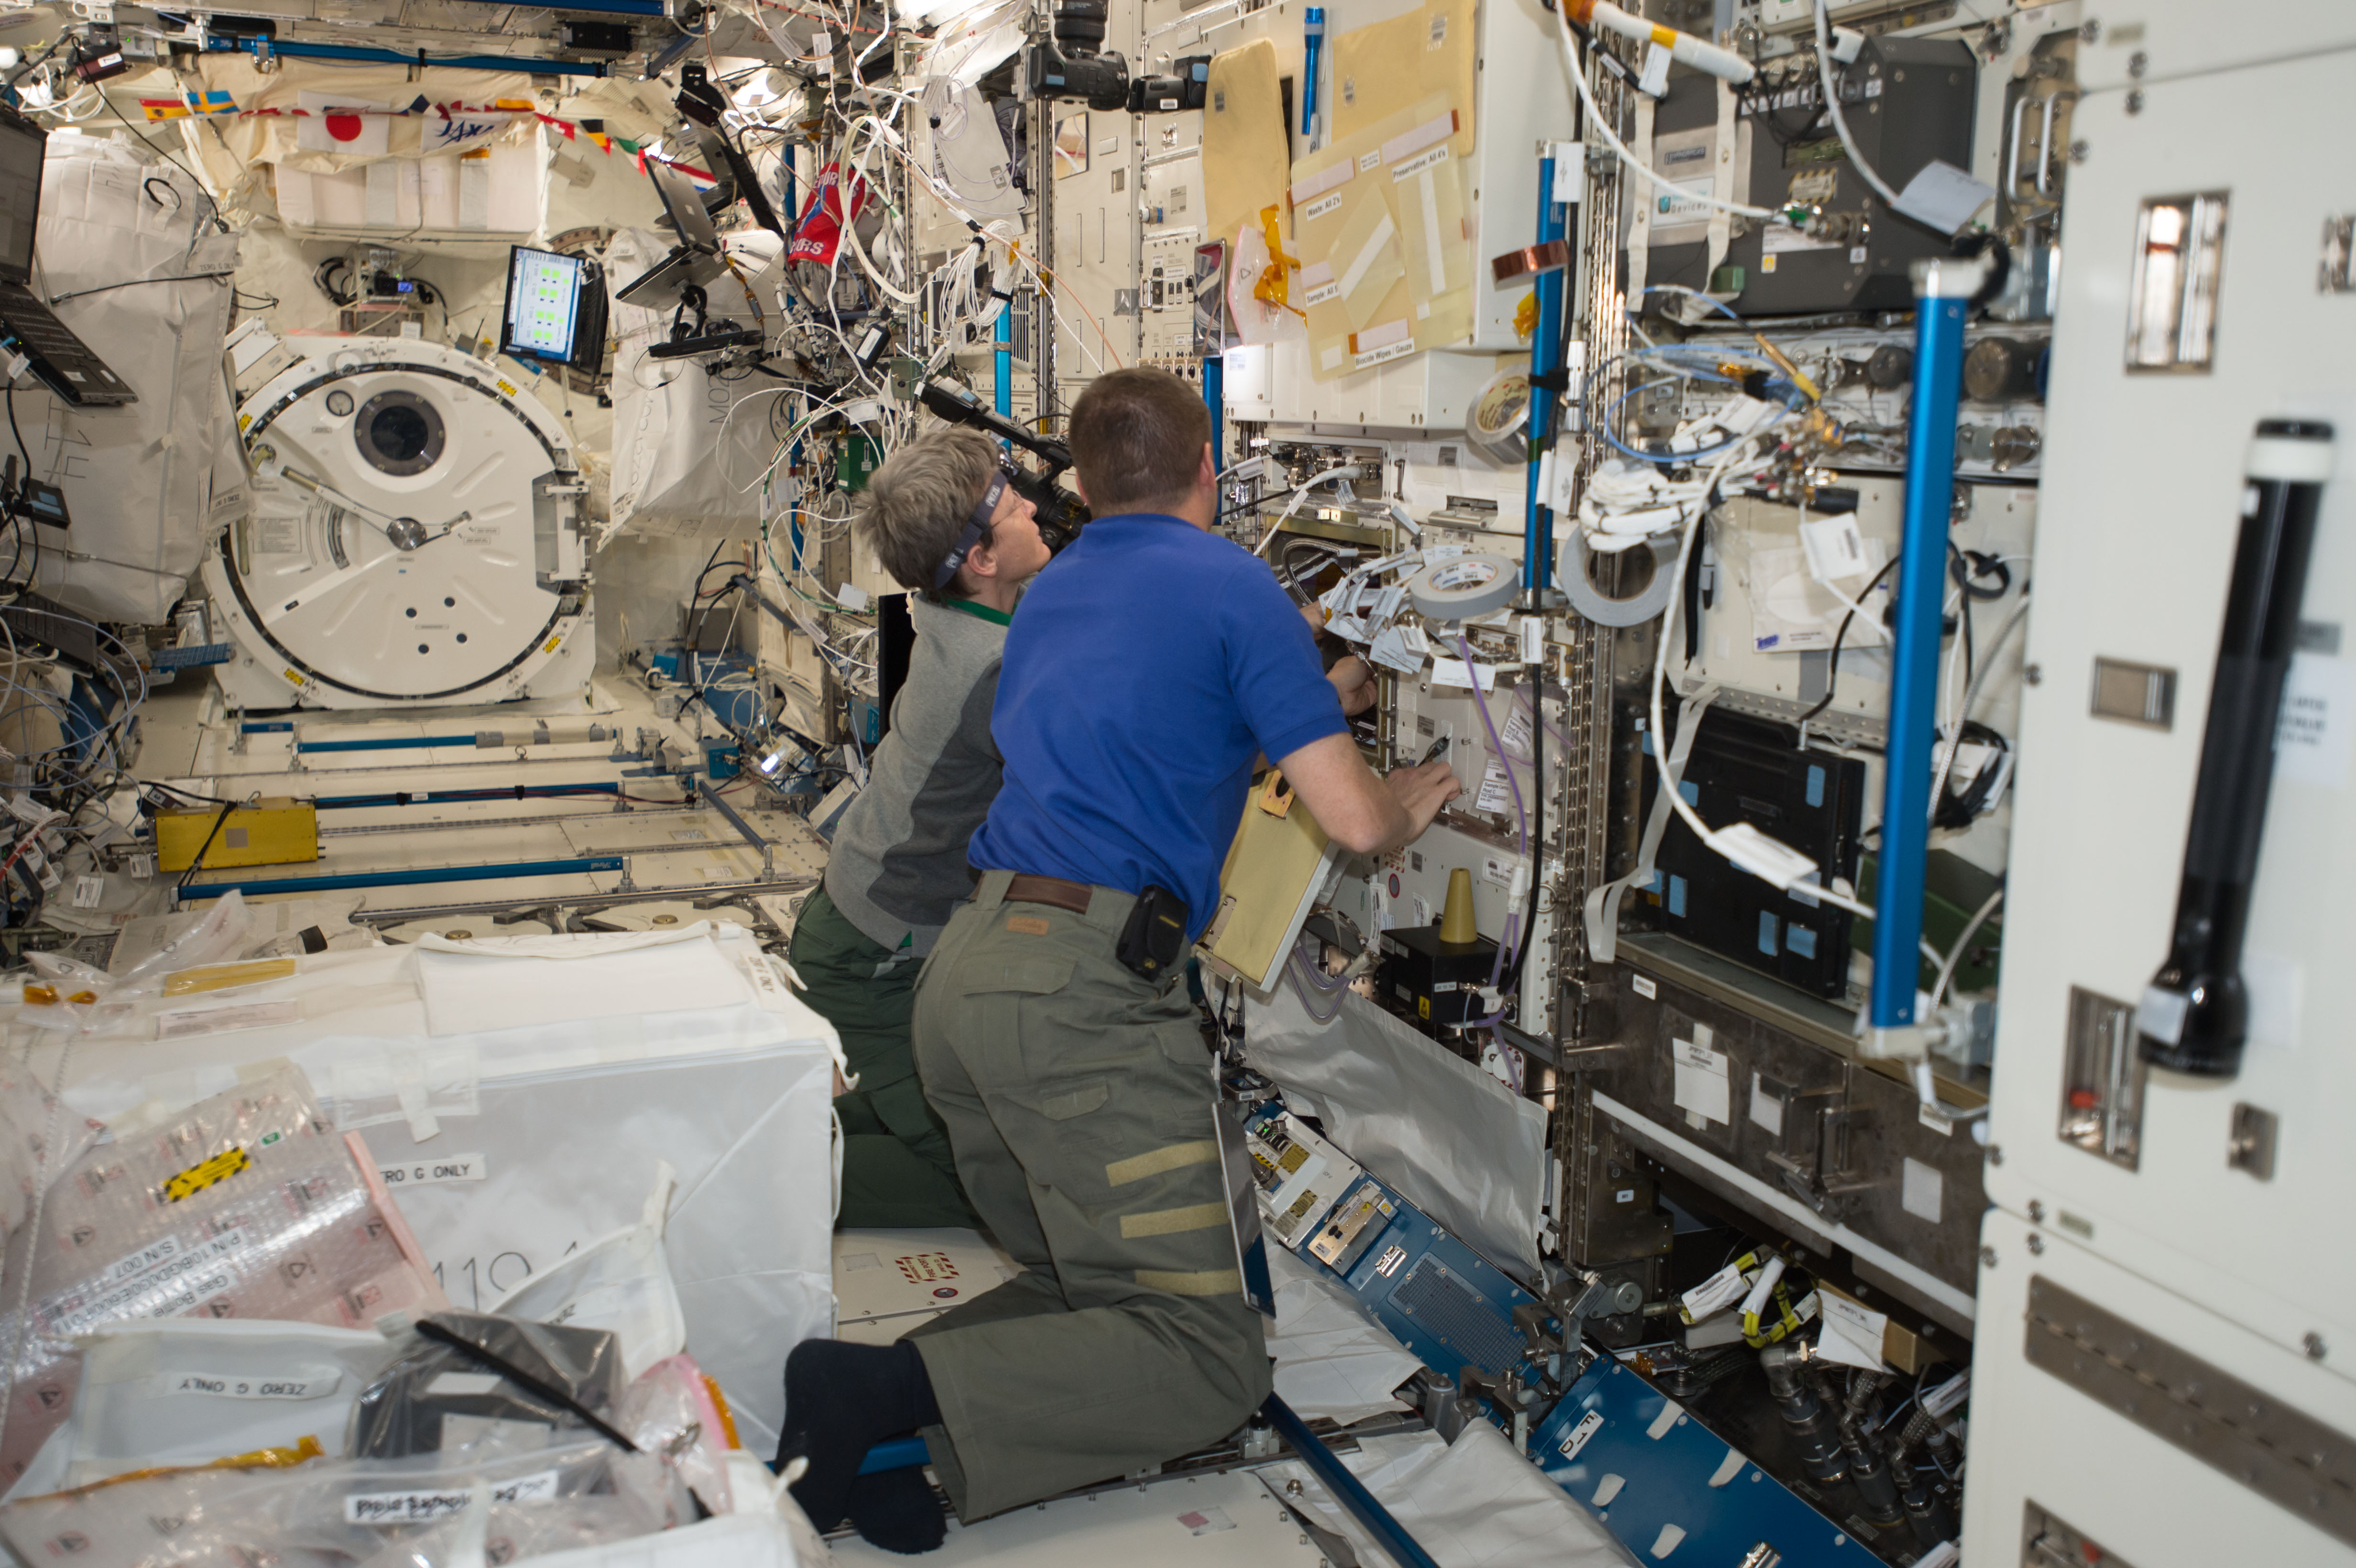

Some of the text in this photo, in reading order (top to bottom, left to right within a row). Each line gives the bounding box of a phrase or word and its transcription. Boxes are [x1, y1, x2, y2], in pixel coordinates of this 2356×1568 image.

[1393, 159, 1428, 179] Preservative:
[1307, 204, 1324, 218] Waste:
[1671, 203, 1707, 214] Devices
[1307, 291, 1326, 304] Sample:
[1355, 354, 1374, 366] Biocide
[1375, 348, 1391, 361] Wipes
[1395, 343, 1413, 354] Gauze
[380, 1164, 471, 1184] RO G ONLY
[211, 1232, 241, 1254] P/N
[114, 1241, 175, 1279] S/N 007
[917, 1258, 938, 1278] FIRE PORT
[153, 1274, 229, 1319] Gas Bottle
[179, 1378, 307, 1396] ZERO G ONLY
